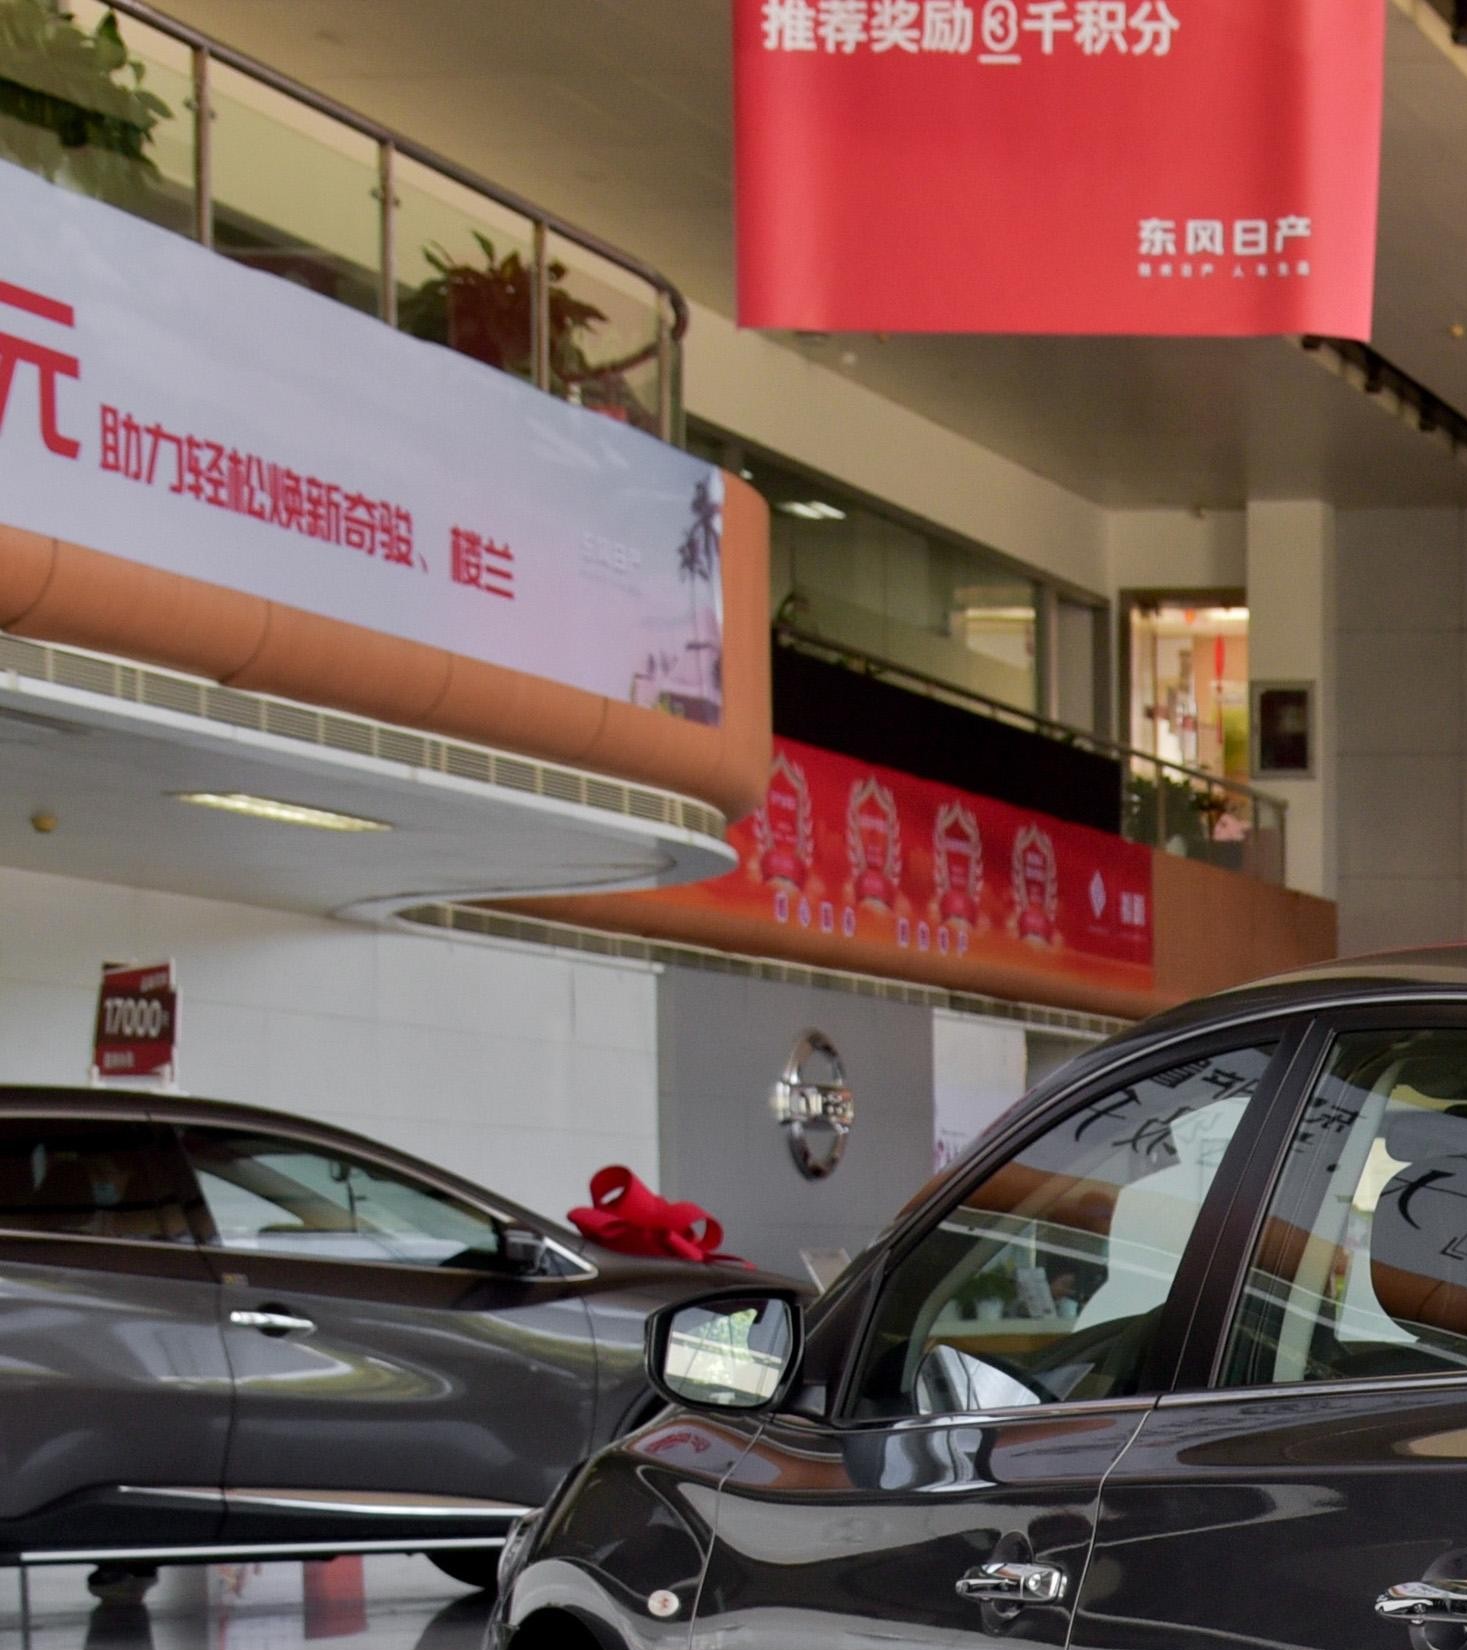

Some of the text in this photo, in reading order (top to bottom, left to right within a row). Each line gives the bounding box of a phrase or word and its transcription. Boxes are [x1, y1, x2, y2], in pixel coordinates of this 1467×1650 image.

[1139, 215, 1311, 256] 东风日产
[0, 280, 81, 461] 元
